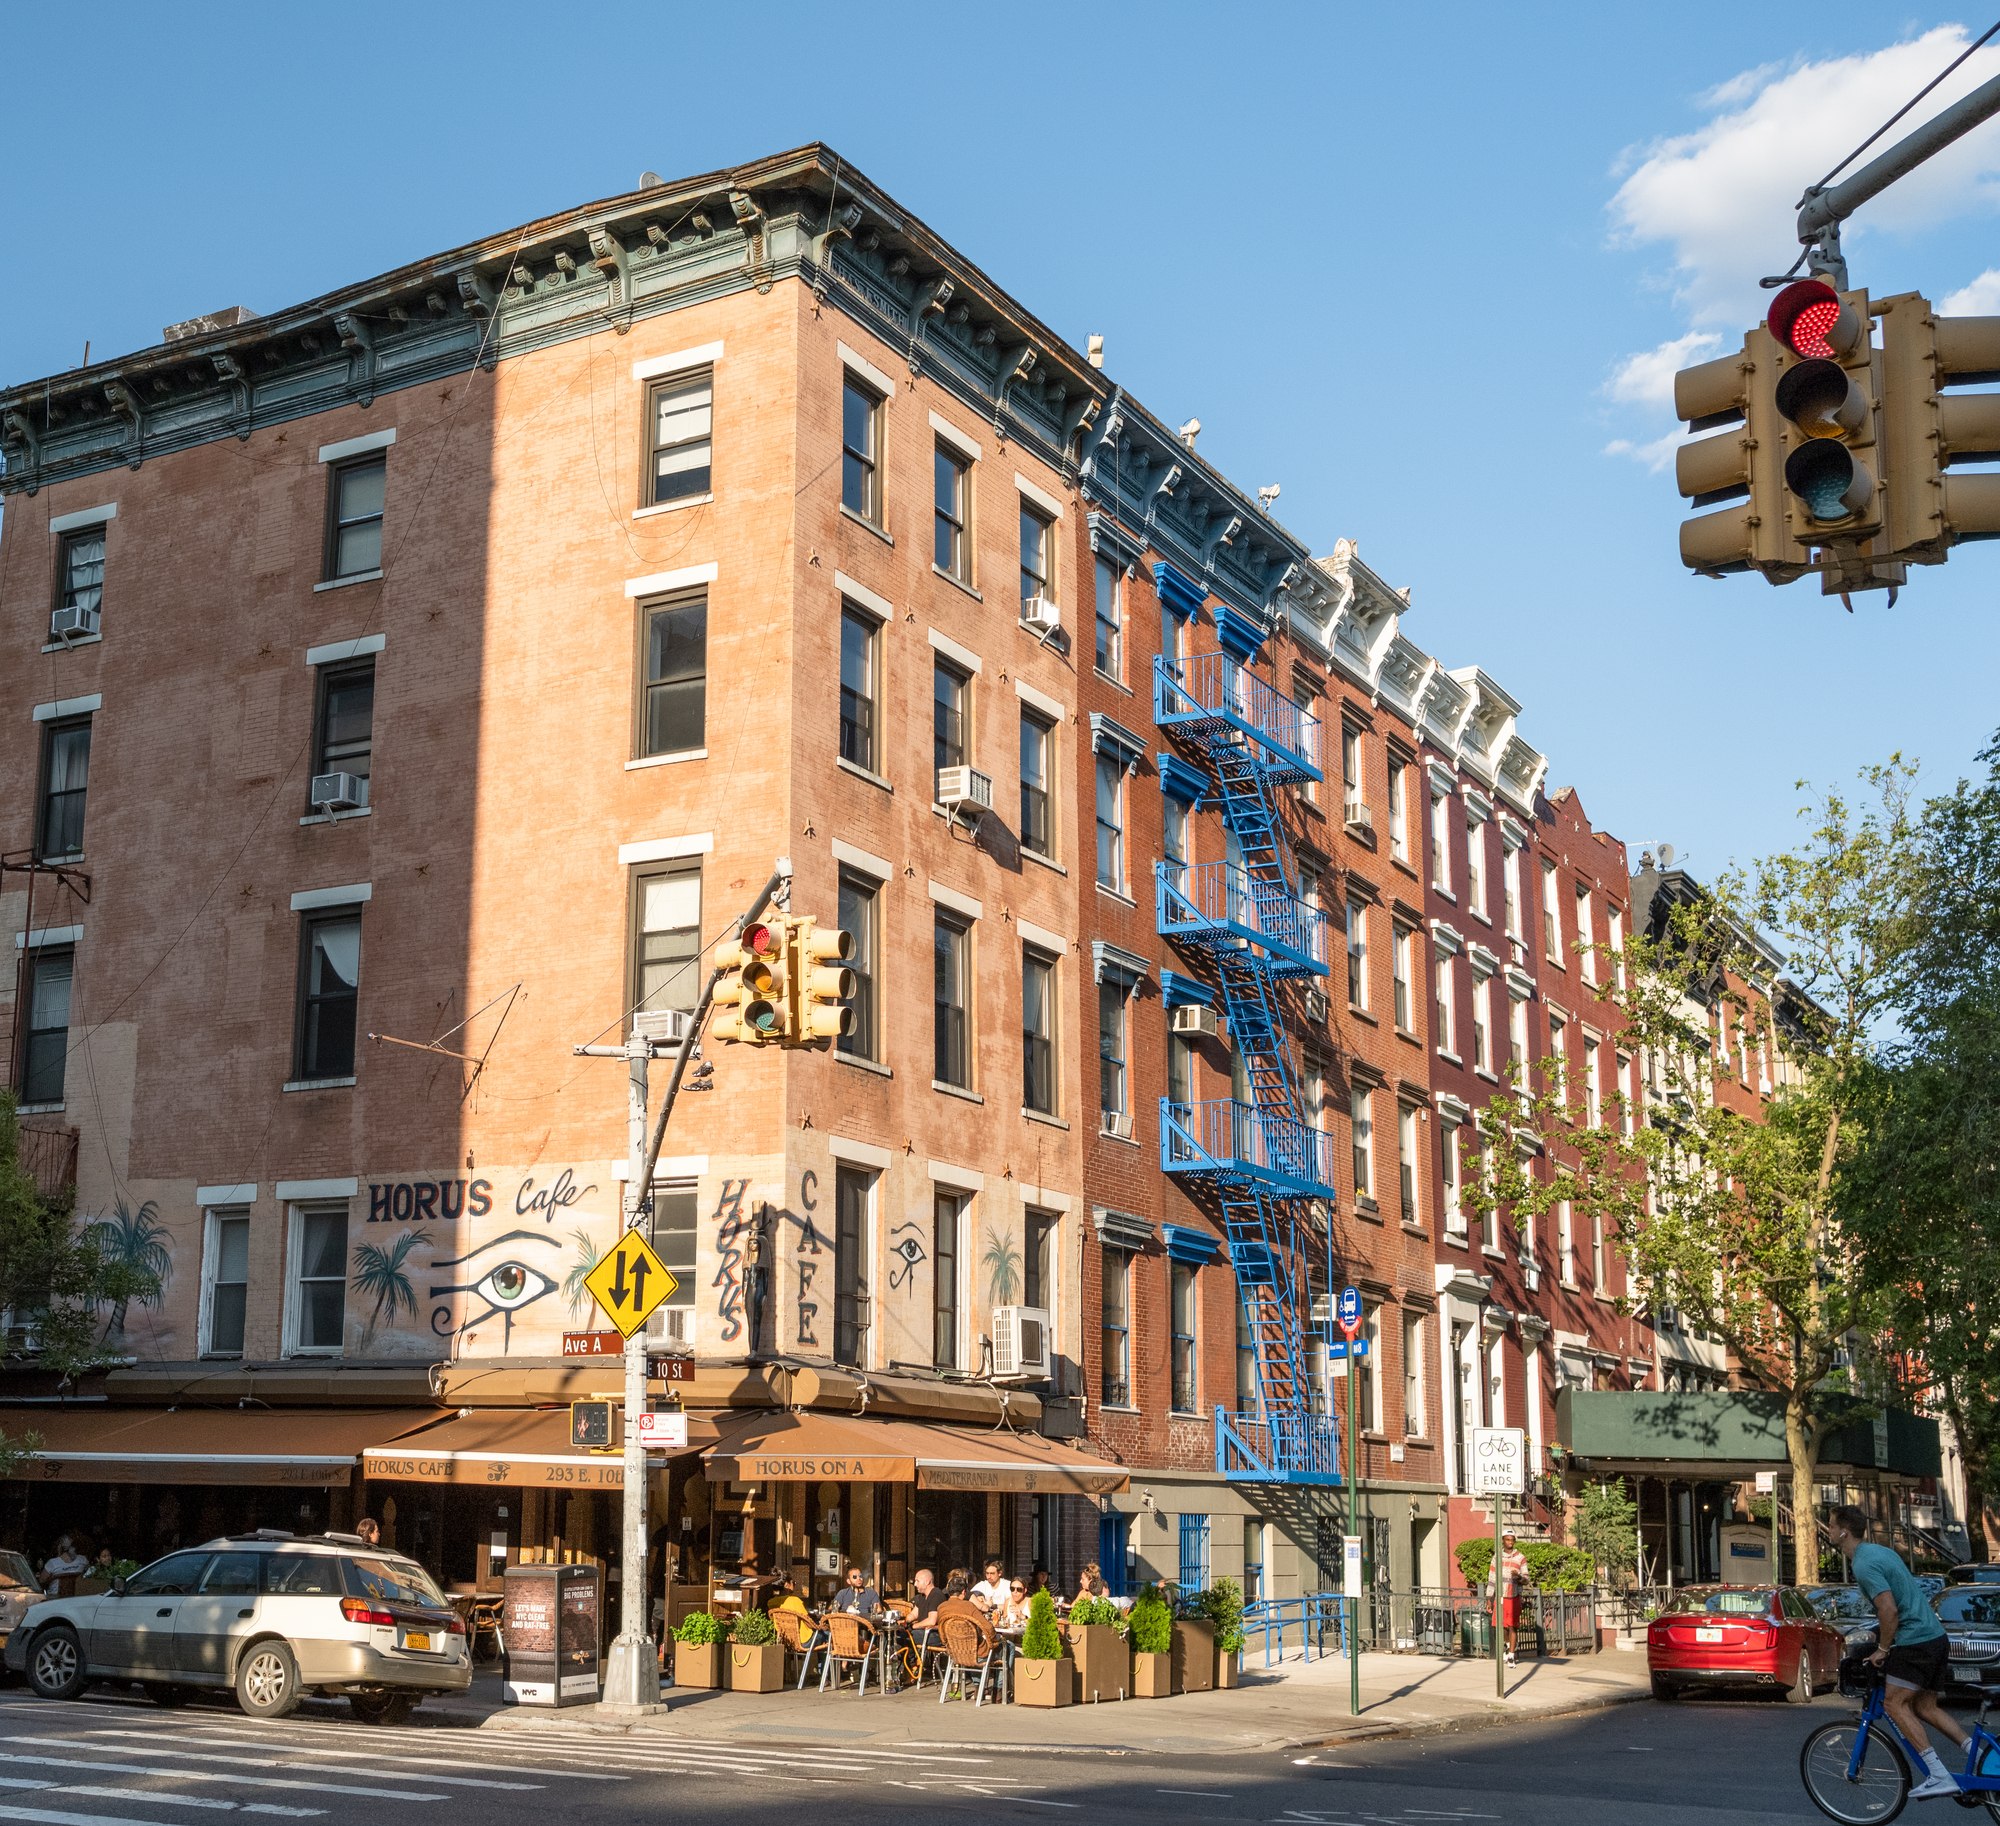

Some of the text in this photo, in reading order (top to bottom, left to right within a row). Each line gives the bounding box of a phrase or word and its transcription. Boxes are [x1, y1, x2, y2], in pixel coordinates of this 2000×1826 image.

[367, 1168, 598, 1223] HORUS Cafe
[712, 1179, 753, 1342] HORUS
[797, 1170, 822, 1347] CAFE
[564, 1337, 602, 1353] Ave A
[648, 1362, 682, 1378] E 10 St
[368, 1460, 453, 1476] HORUS CAFE
[546, 1467, 573, 1482] 293
[578, 1468, 591, 1483] E.
[755, 1460, 864, 1475] HORUS ON A
[1483, 1463, 1513, 1473] LANE
[928, 1470, 999, 1486] MEDITERRANEAN
[1483, 1476, 1513, 1486] ENDS
[830, 1512, 838, 1526] A
[571, 1590, 594, 1598] PROBLEMS
[530, 1604, 546, 1613] MAKE
[527, 1613, 545, 1621] CLEAN
[522, 1688, 537, 1696] NYC
